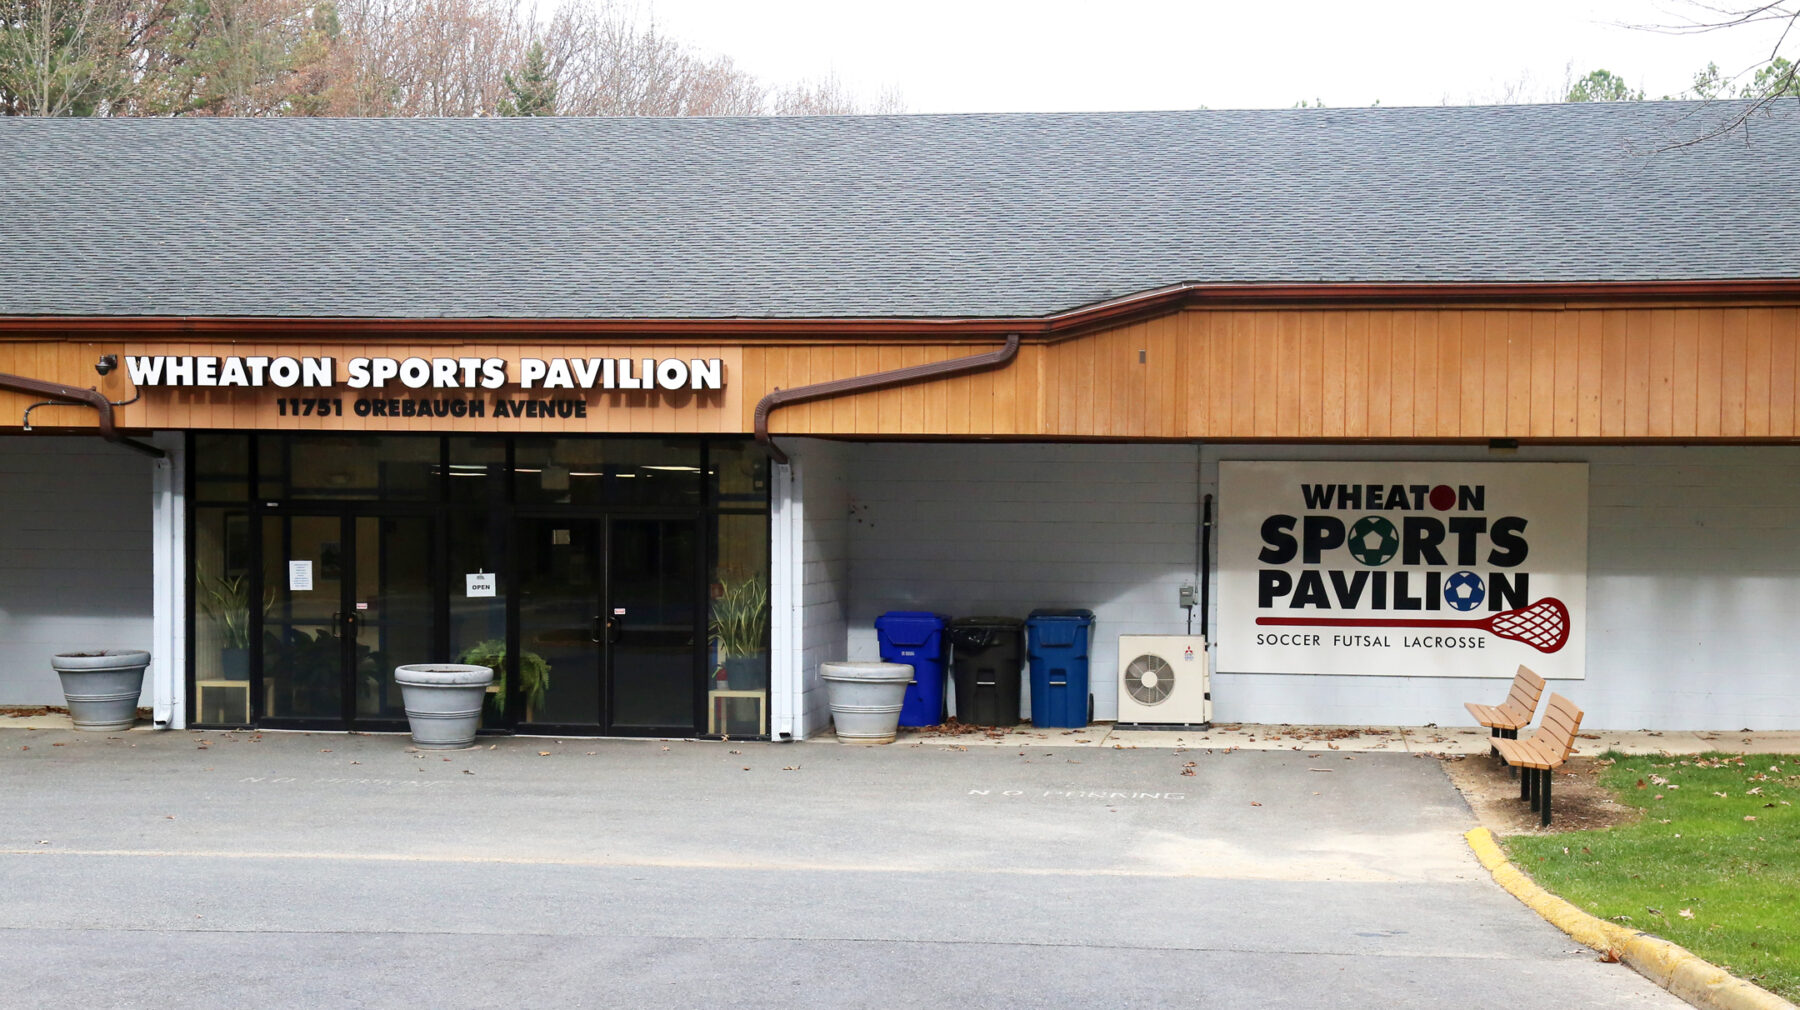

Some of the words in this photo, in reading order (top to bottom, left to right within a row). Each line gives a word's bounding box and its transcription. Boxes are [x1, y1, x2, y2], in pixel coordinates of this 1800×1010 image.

[124, 356, 332, 387] WHEATON
[347, 357, 505, 388] SPORTS
[520, 358, 721, 390] PAVILION
[277, 398, 342, 417] 11751
[354, 399, 485, 417] OREBAUGH
[493, 399, 587, 418] AVENUE
[1301, 484, 1485, 511] WHEATON
[1258, 514, 1529, 567] SPORTS
[1258, 569, 1529, 612] PAVILION
[1256, 633, 1321, 646] SOCCER
[1333, 634, 1391, 648] FUTSAL
[1404, 636, 1486, 649] LACROSSE
